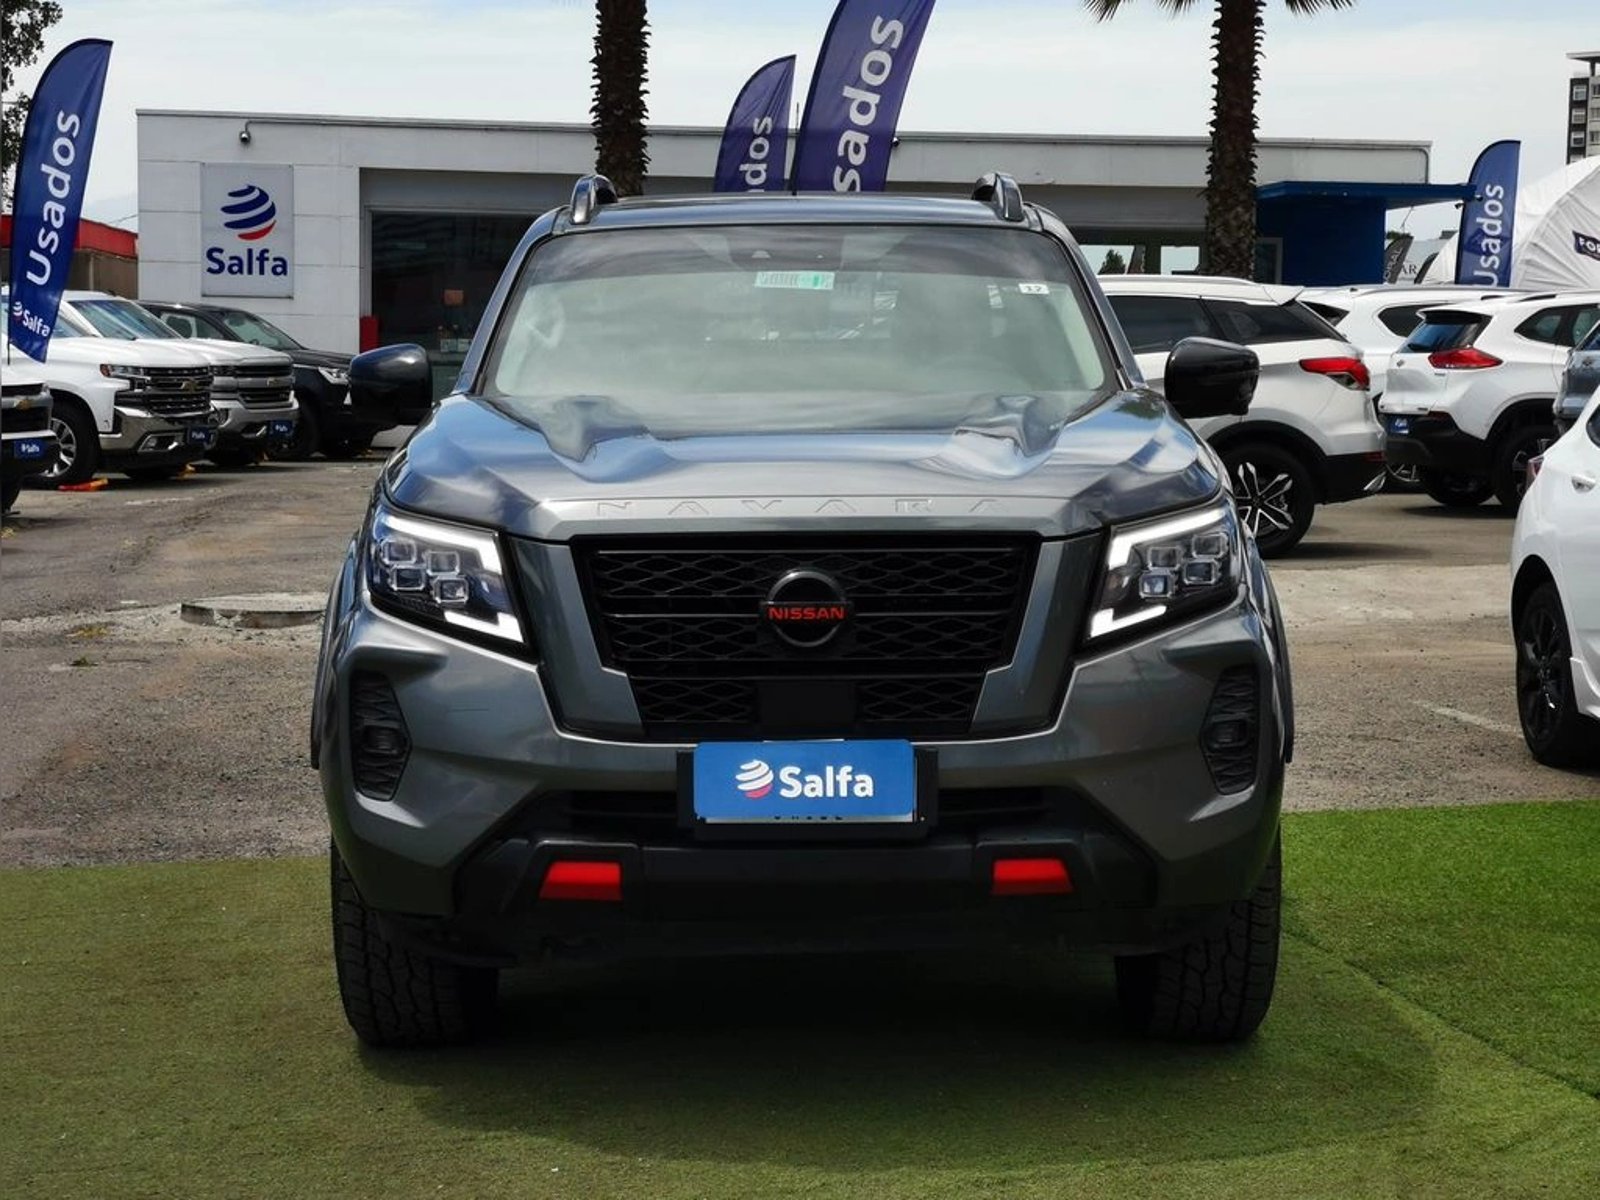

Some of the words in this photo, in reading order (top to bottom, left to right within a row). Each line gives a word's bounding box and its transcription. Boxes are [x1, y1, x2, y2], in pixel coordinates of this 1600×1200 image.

[739, 116, 774, 192] dos
[26, 110, 80, 286] Usados
[206, 247, 288, 277] Salfa
[22, 308, 50, 337] Salfa
[597, 498, 1009, 518] NAVARA
[768, 606, 846, 620] NISSAN
[779, 765, 875, 799] Salfa
